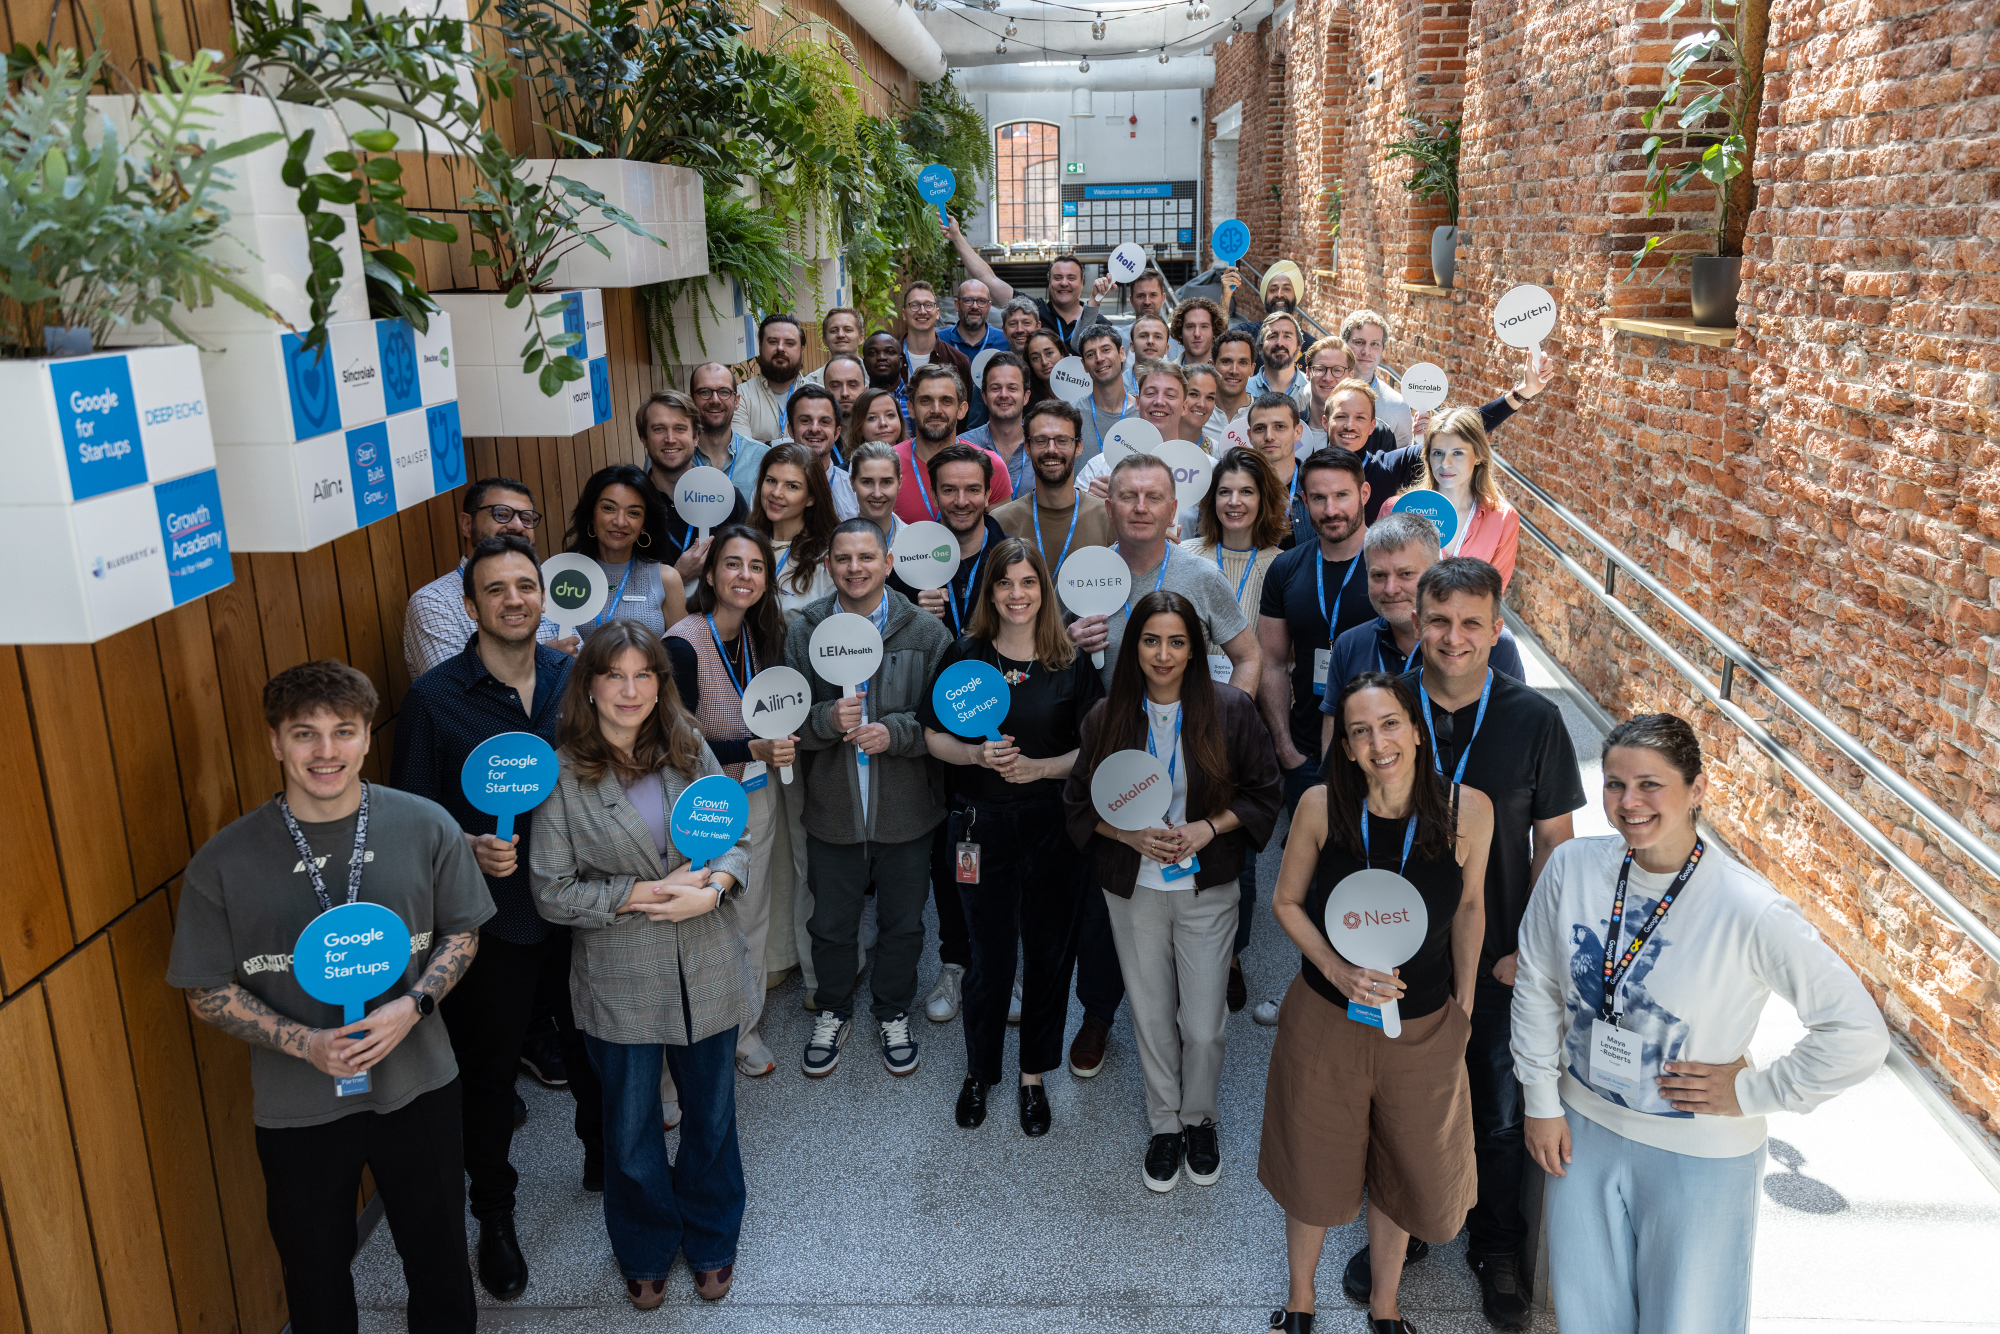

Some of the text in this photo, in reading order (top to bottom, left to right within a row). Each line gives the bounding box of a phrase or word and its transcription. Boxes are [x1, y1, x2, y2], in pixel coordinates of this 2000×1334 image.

[1116, 252, 1136, 273] holi.
[1499, 302, 1552, 329] YOU(th)
[342, 365, 375, 383] Sincrolab
[1066, 374, 1090, 388] kanjo
[1408, 382, 1442, 392] Sincrolab
[70, 387, 119, 414] Google
[145, 400, 204, 426] DEEP ECHO
[75, 418, 95, 438] for
[79, 439, 131, 464] Startups
[401, 449, 428, 468] DAISER
[166, 504, 210, 533] Growth
[1405, 506, 1438, 515] Growth
[172, 530, 222, 561] Academy
[899, 549, 950, 563] Doctor. One
[555, 581, 586, 598] dru
[1077, 577, 1122, 588] DAISER
[945, 676, 982, 701] Google
[951, 699, 967, 713] for
[957, 695, 998, 724] Startups
[488, 753, 538, 768] Google
[488, 768, 507, 780] for
[485, 780, 539, 795] Startups
[1108, 773, 1160, 812] takalam
[693, 796, 729, 809] Growth
[689, 811, 733, 826] Academy
[710, 832, 730, 840] Health
[1679, 862, 1695, 881] Google
[1617, 880, 1626, 900] Google
[1364, 908, 1410, 926] Nest
[1644, 914, 1660, 933] Google
[324, 928, 384, 947] Google
[325, 951, 348, 963] for
[1606, 940, 1616, 960] Google
[324, 960, 390, 979] Startups
[1610, 967, 1624, 984] Google
[1600, 1041, 1631, 1056] Leventer
[1607, 1035, 1625, 1047] Maya
[1600, 1049, 1631, 1064] -Roberts
[342, 1077, 365, 1085] Partner
